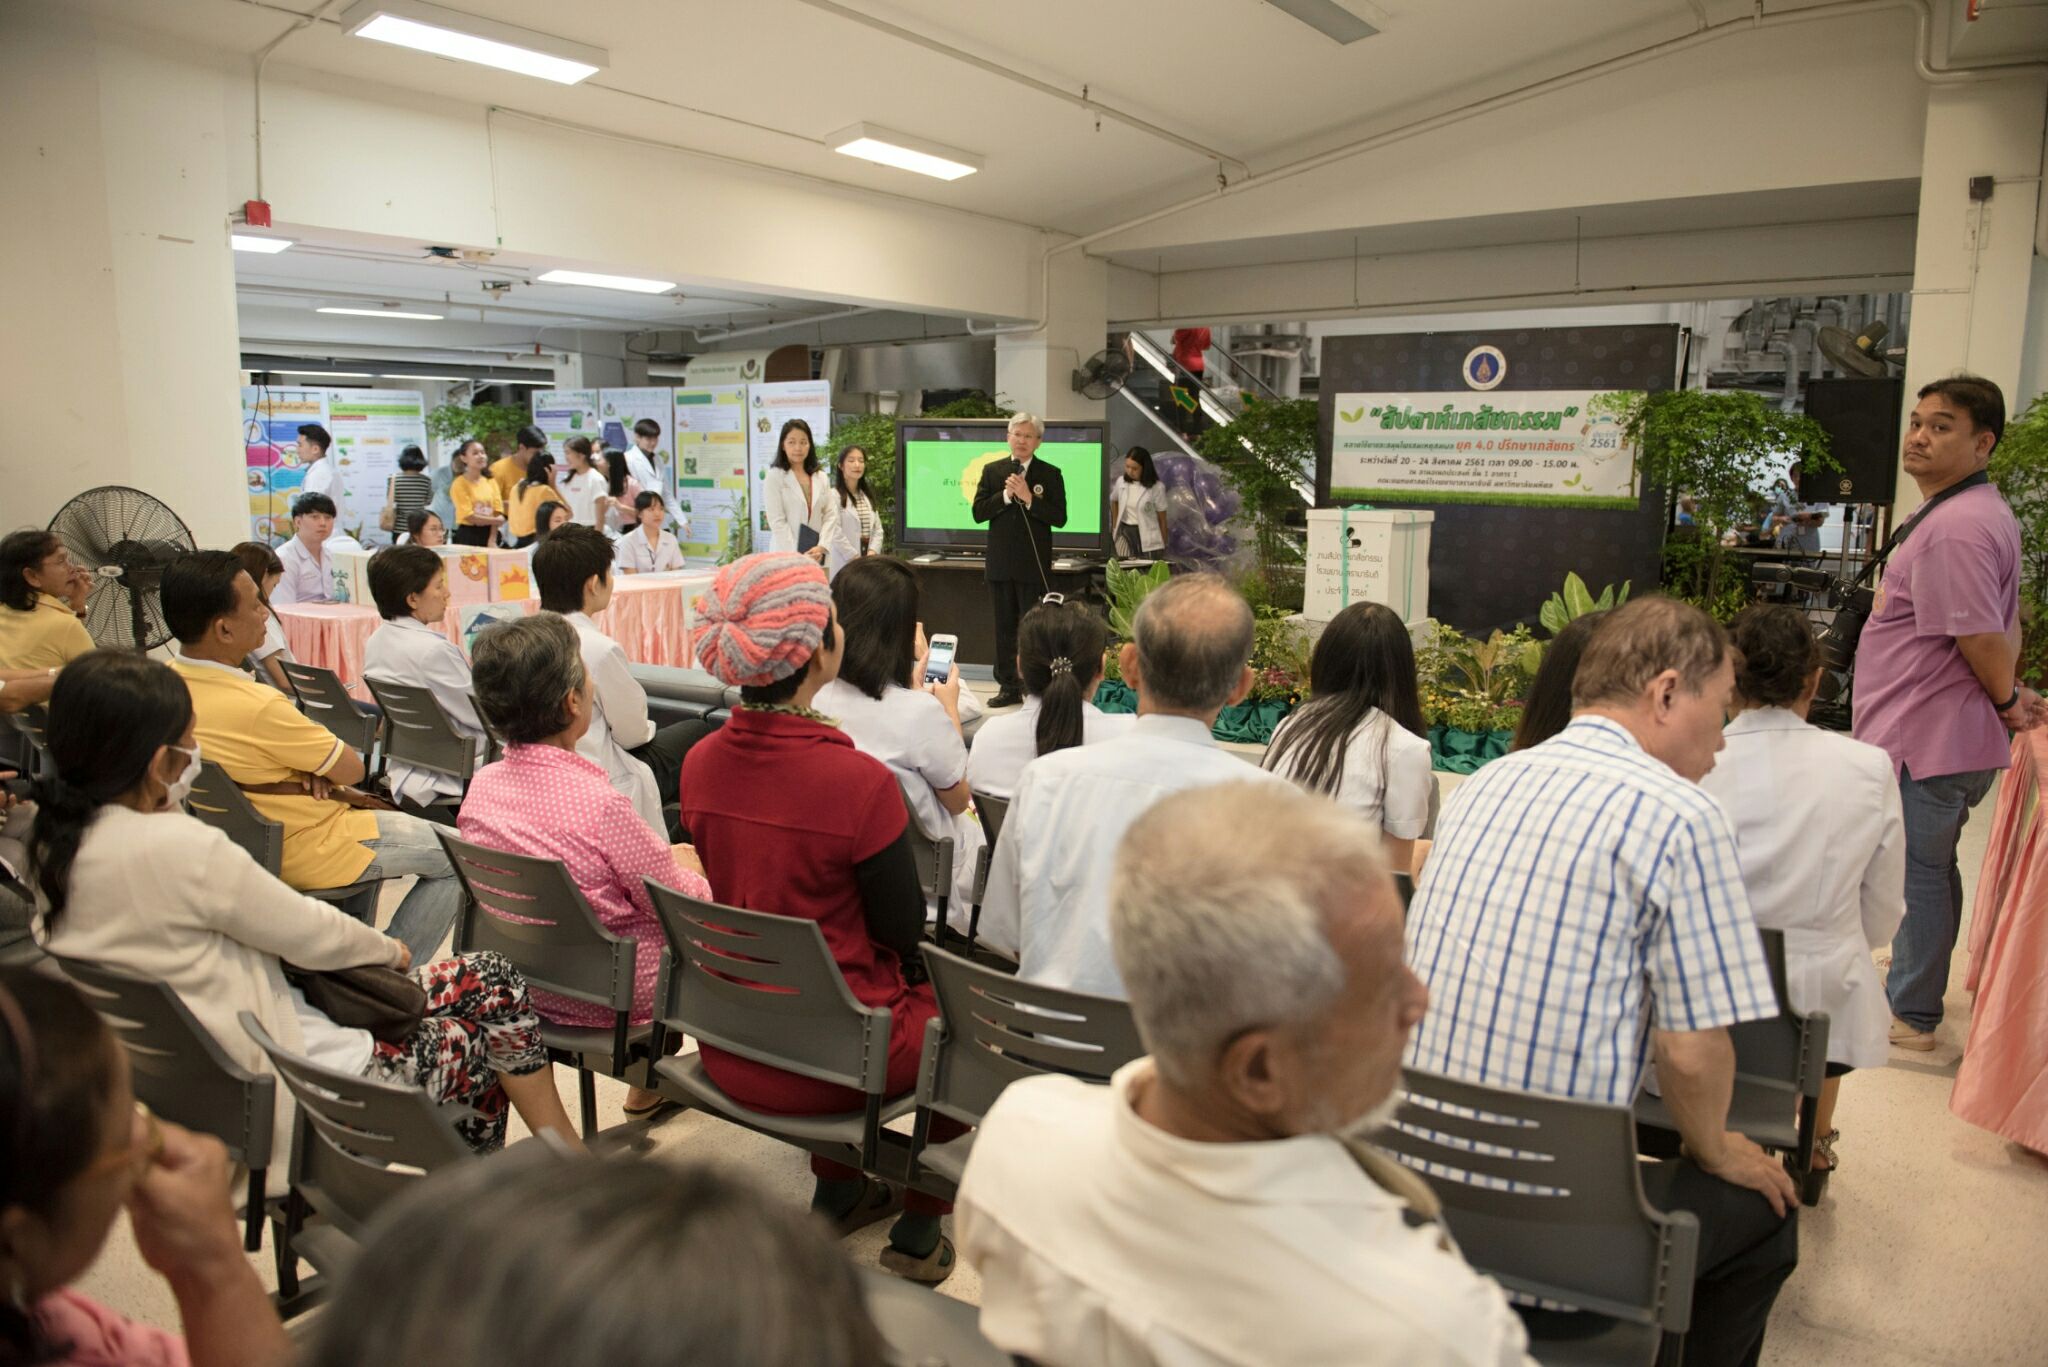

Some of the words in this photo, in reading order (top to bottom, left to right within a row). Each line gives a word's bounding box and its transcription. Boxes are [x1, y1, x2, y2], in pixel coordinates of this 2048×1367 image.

[1456, 441, 1472, 453] ยุค
[1475, 440, 1494, 450] 4.0
[1590, 438, 1616, 448] 2561
[1400, 456, 1411, 465] 20
[1419, 457, 1429, 465] 24
[1431, 456, 1462, 466] สิงหาคม
[1464, 457, 1486, 467] 2561
[1507, 458, 1533, 468] 09.00
[1542, 460, 1568, 468] 15.00
[1351, 588, 1368, 597] 2561
